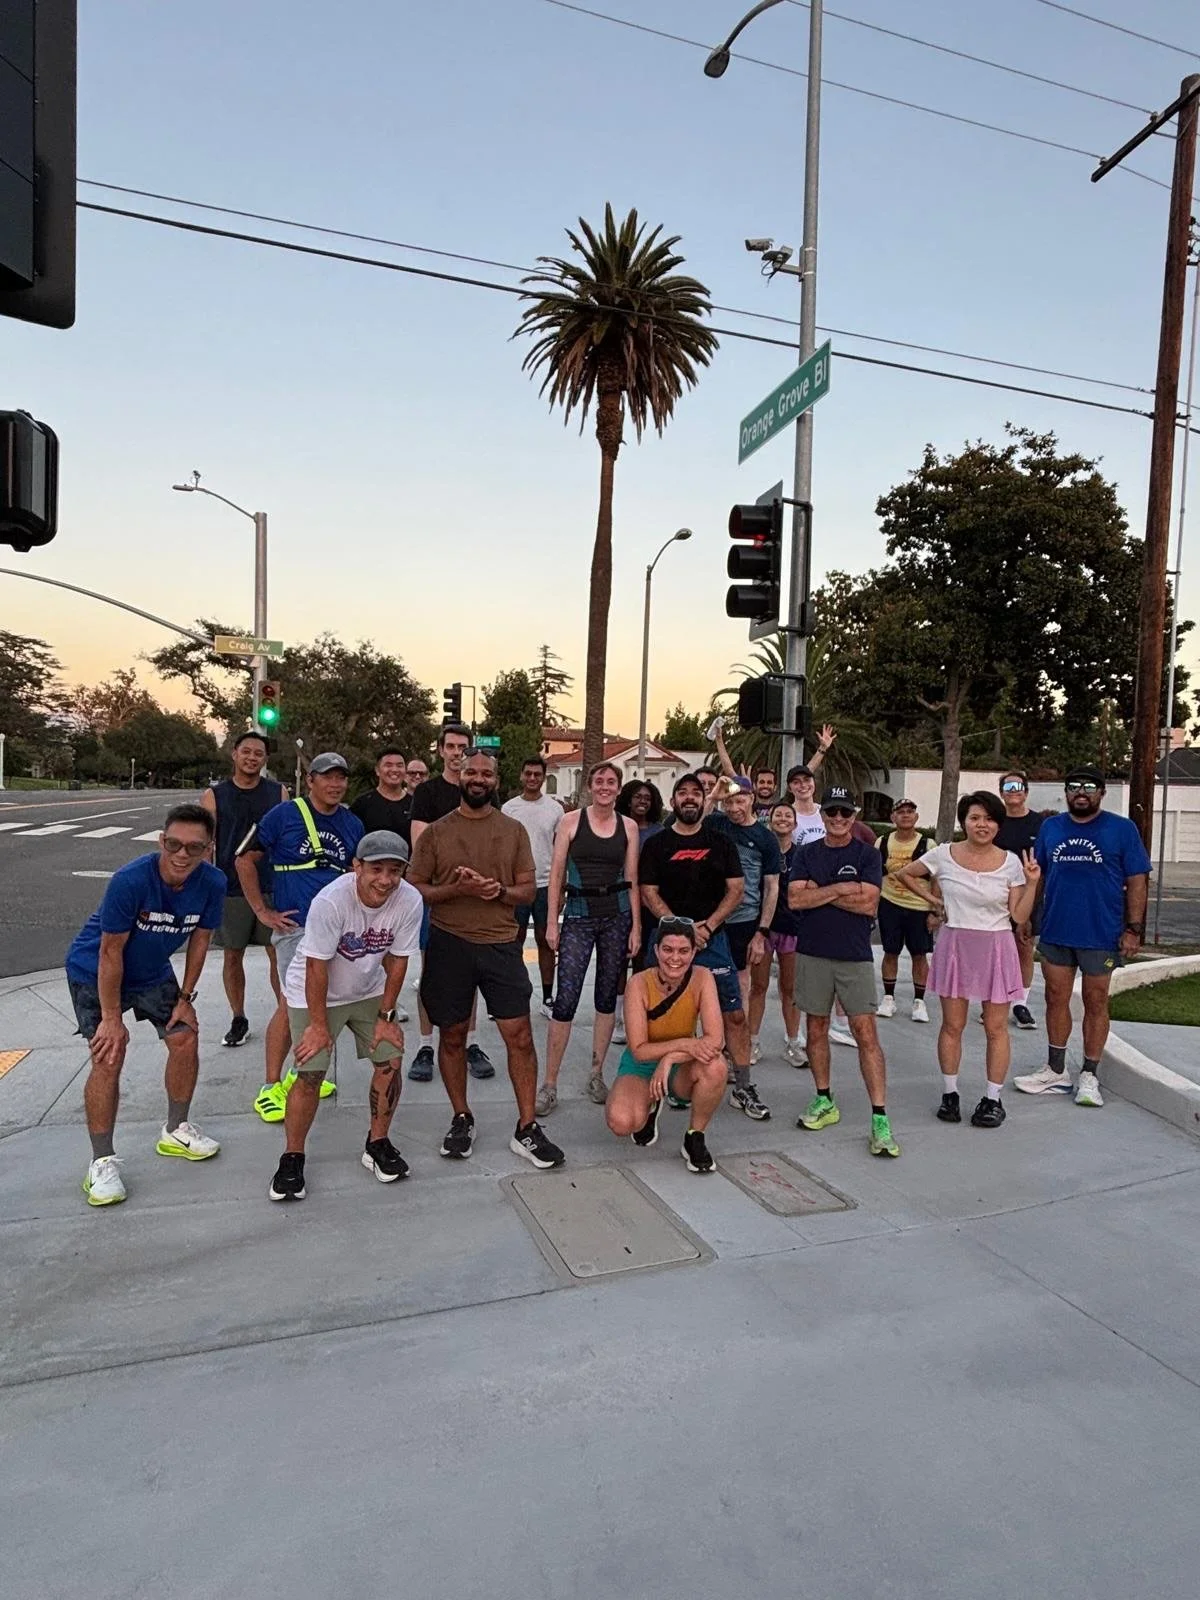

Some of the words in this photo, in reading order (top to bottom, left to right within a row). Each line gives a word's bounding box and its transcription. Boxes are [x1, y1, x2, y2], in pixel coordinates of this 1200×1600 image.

[741, 408, 774, 449] Orange
[778, 377, 810, 417] Grove
[814, 355, 827, 389] Bl
[228, 640, 254, 653] Craig
[257, 642, 271, 652] Av
[317, 831, 342, 847] WITH
[1053, 842, 1067, 863] RUN
[1068, 838, 1096, 850] WITH
[1092, 849, 1103, 863] US
